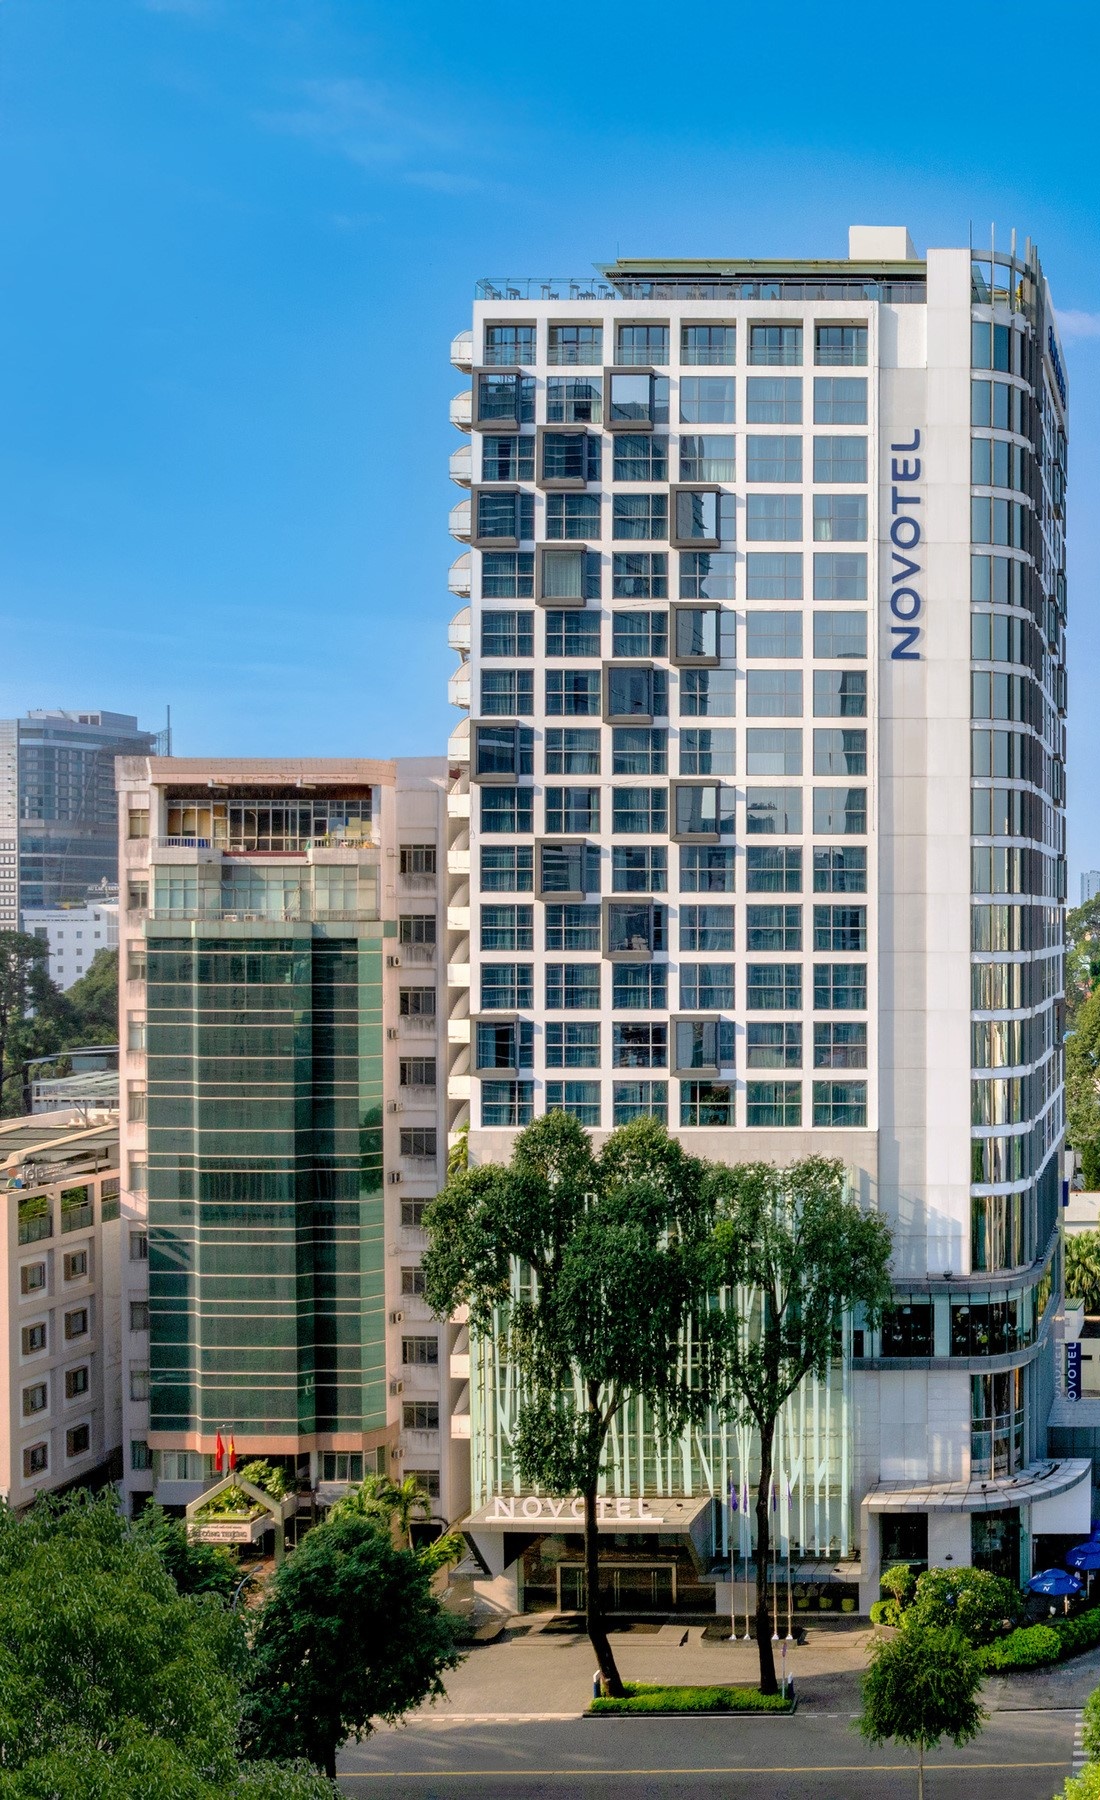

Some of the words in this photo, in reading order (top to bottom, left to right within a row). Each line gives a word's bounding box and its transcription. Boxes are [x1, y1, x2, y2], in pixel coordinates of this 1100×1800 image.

[890, 428, 921, 660] NOVOTEL
[1067, 1342, 1077, 1401] OVOTEL
[494, 1496, 652, 1518] NOVOTEL
